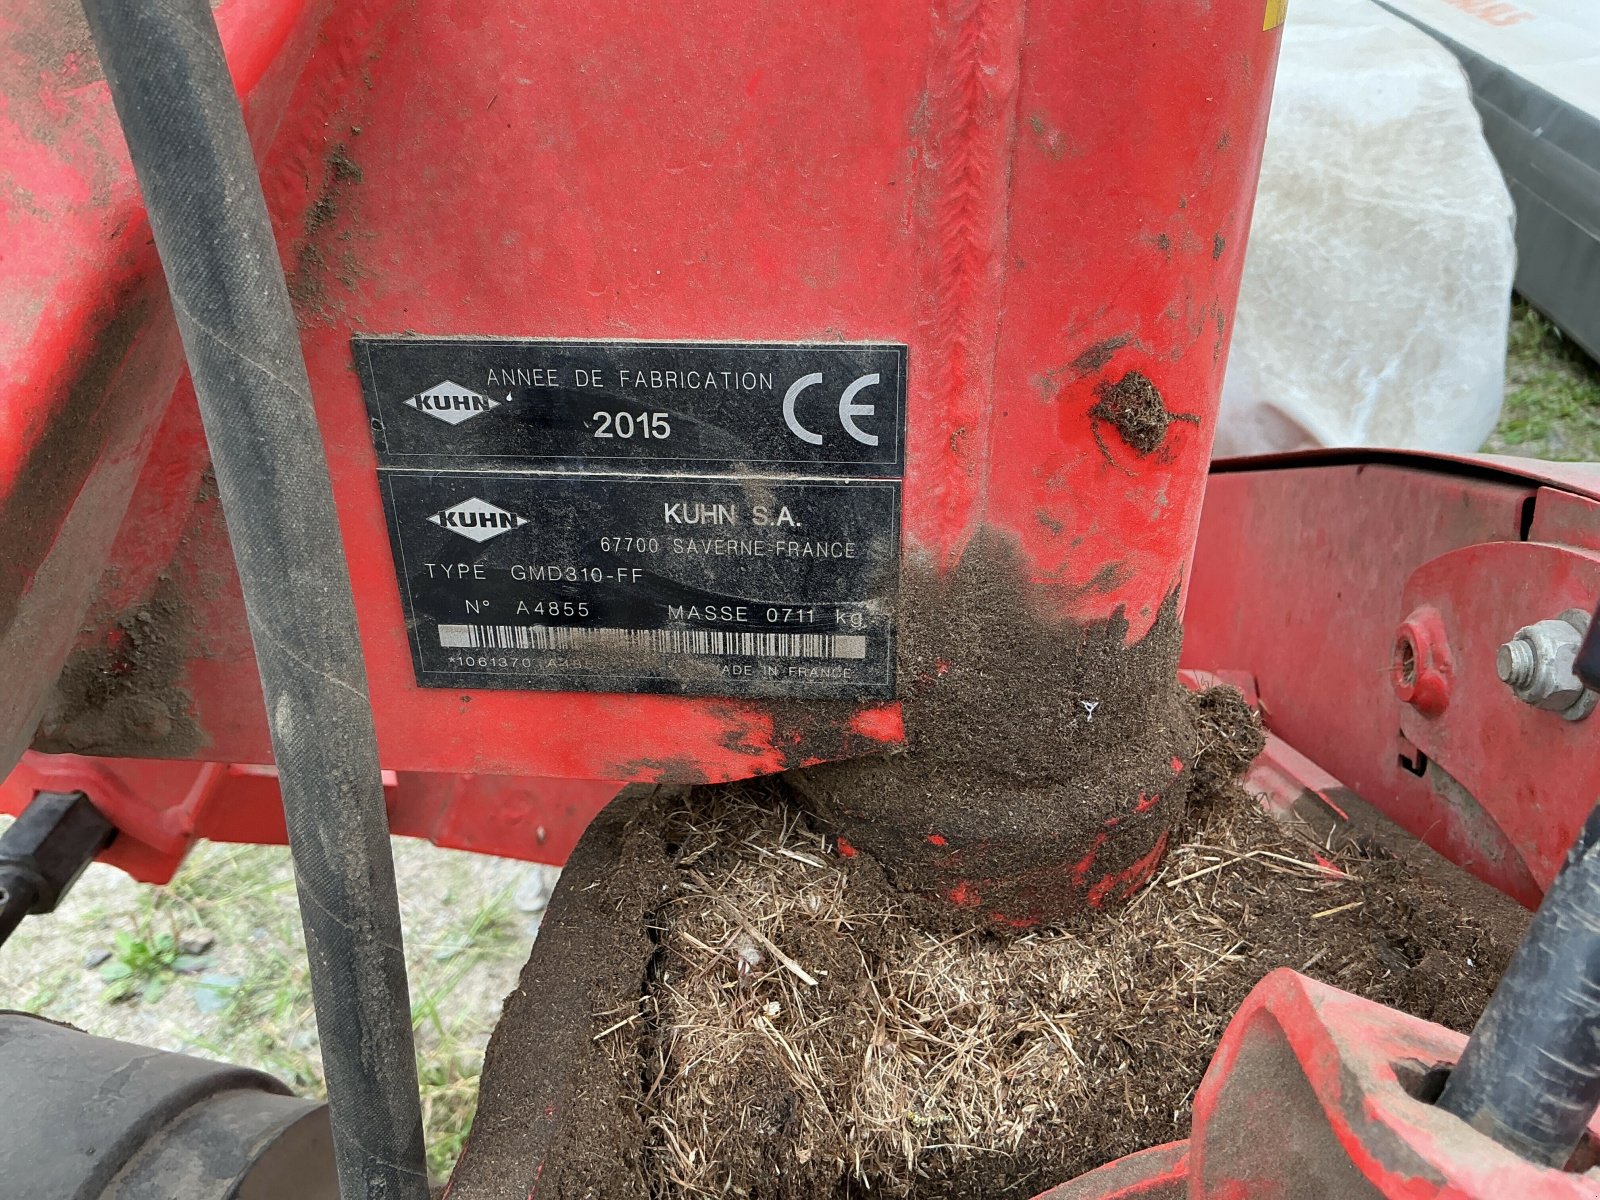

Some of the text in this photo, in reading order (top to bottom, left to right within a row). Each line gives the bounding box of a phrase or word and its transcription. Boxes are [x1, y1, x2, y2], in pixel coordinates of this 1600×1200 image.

[486, 367, 774, 391] ANNEE DE FABRICATION
[414, 393, 490, 412] KUHN
[782, 372, 881, 447] CE
[592, 411, 671, 440] 2015
[437, 511, 519, 529] KUHN
[663, 502, 802, 527] KUHN S.A.
[600, 536, 857, 559] 67700 SAVERNE-FRANCE
[424, 563, 643, 584] TYPE GMD310-FF
[516, 600, 590, 617] A4855
[667, 604, 865, 629] MASSE 0711 kg
[715, 664, 852, 680] ADE IN FRANCE
